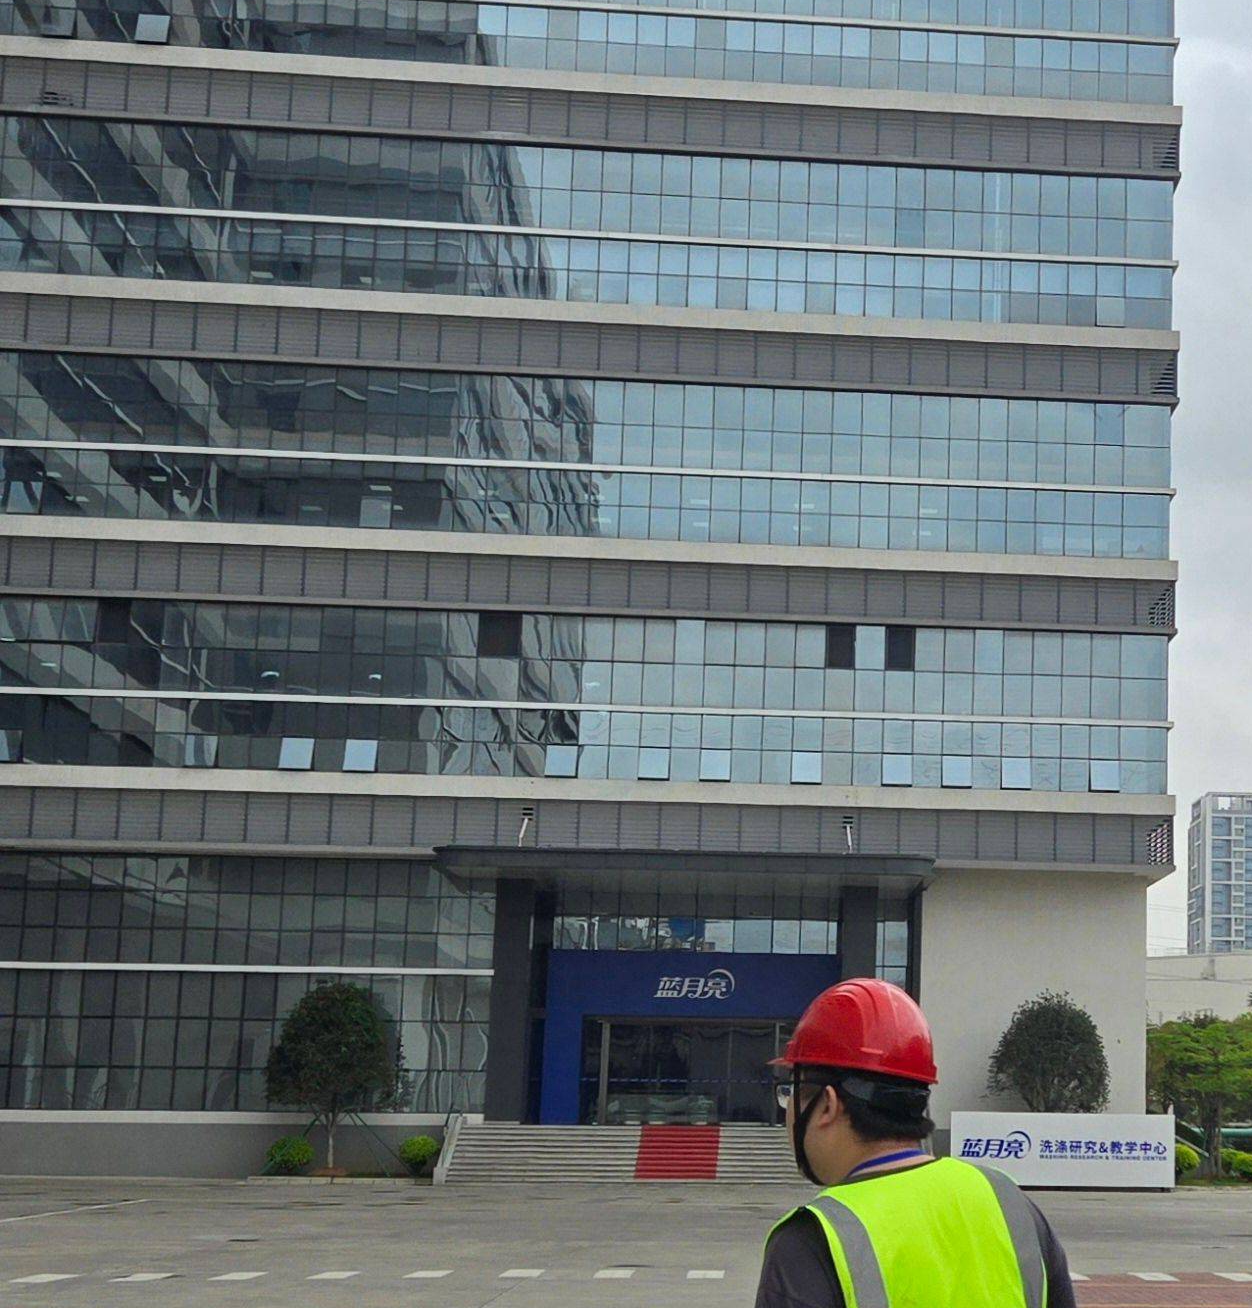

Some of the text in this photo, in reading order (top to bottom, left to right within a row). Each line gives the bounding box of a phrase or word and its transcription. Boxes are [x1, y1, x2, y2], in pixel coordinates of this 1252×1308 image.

[653, 968, 735, 999] 蓝月亮
[959, 1130, 1032, 1159] 蓝月亮
[1039, 1139, 1167, 1155] 洗涤研究&教学中心
